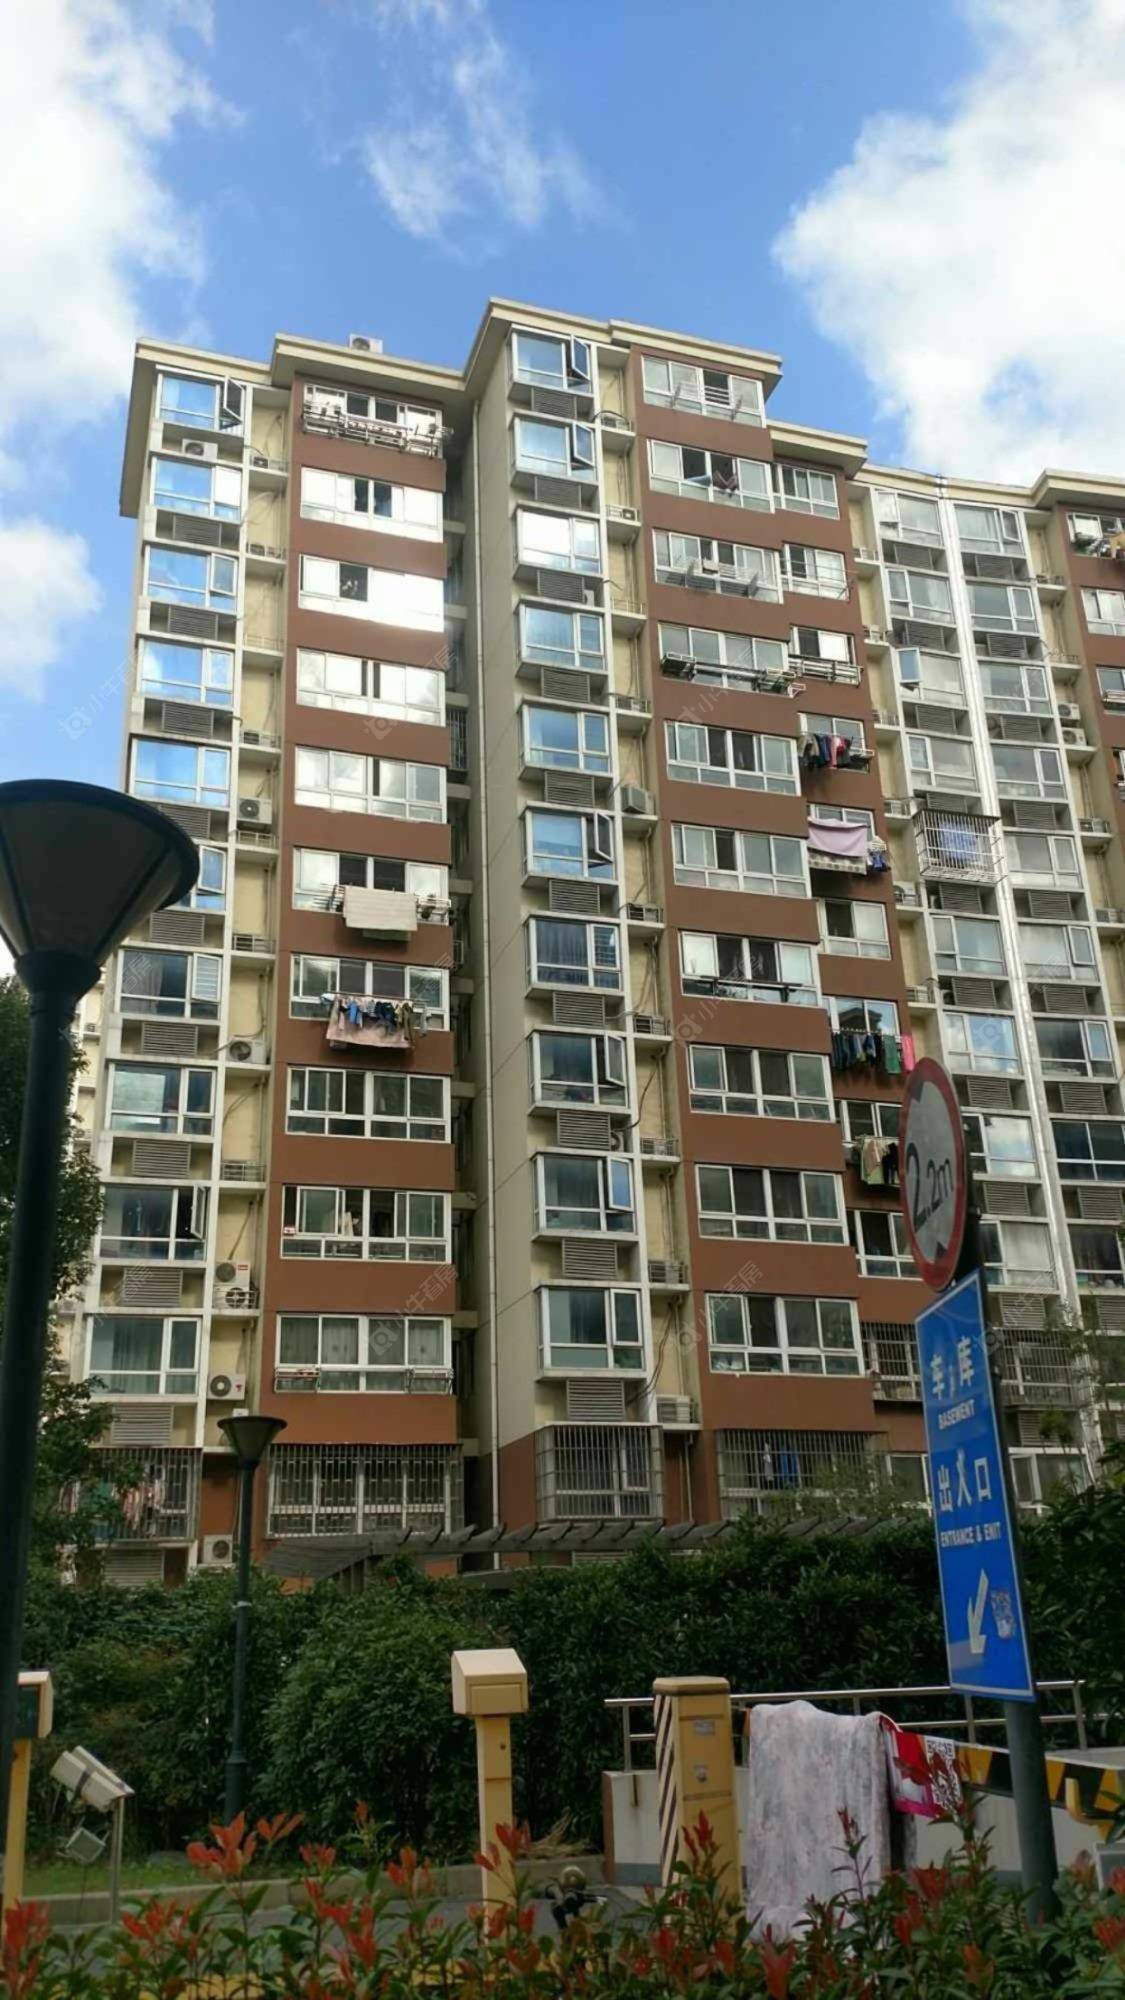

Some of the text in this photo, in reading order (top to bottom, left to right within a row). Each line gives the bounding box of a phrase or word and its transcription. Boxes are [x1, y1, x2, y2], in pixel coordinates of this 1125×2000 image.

[906, 1142, 954, 1233] 2.2m
[930, 1336, 974, 1400] 车库
[938, 1399, 975, 1429] BASEMENT
[937, 1447, 993, 1512] 出入口
[940, 1526, 974, 1548] ENTRANCE
[983, 1521, 1001, 1541] EXIT
